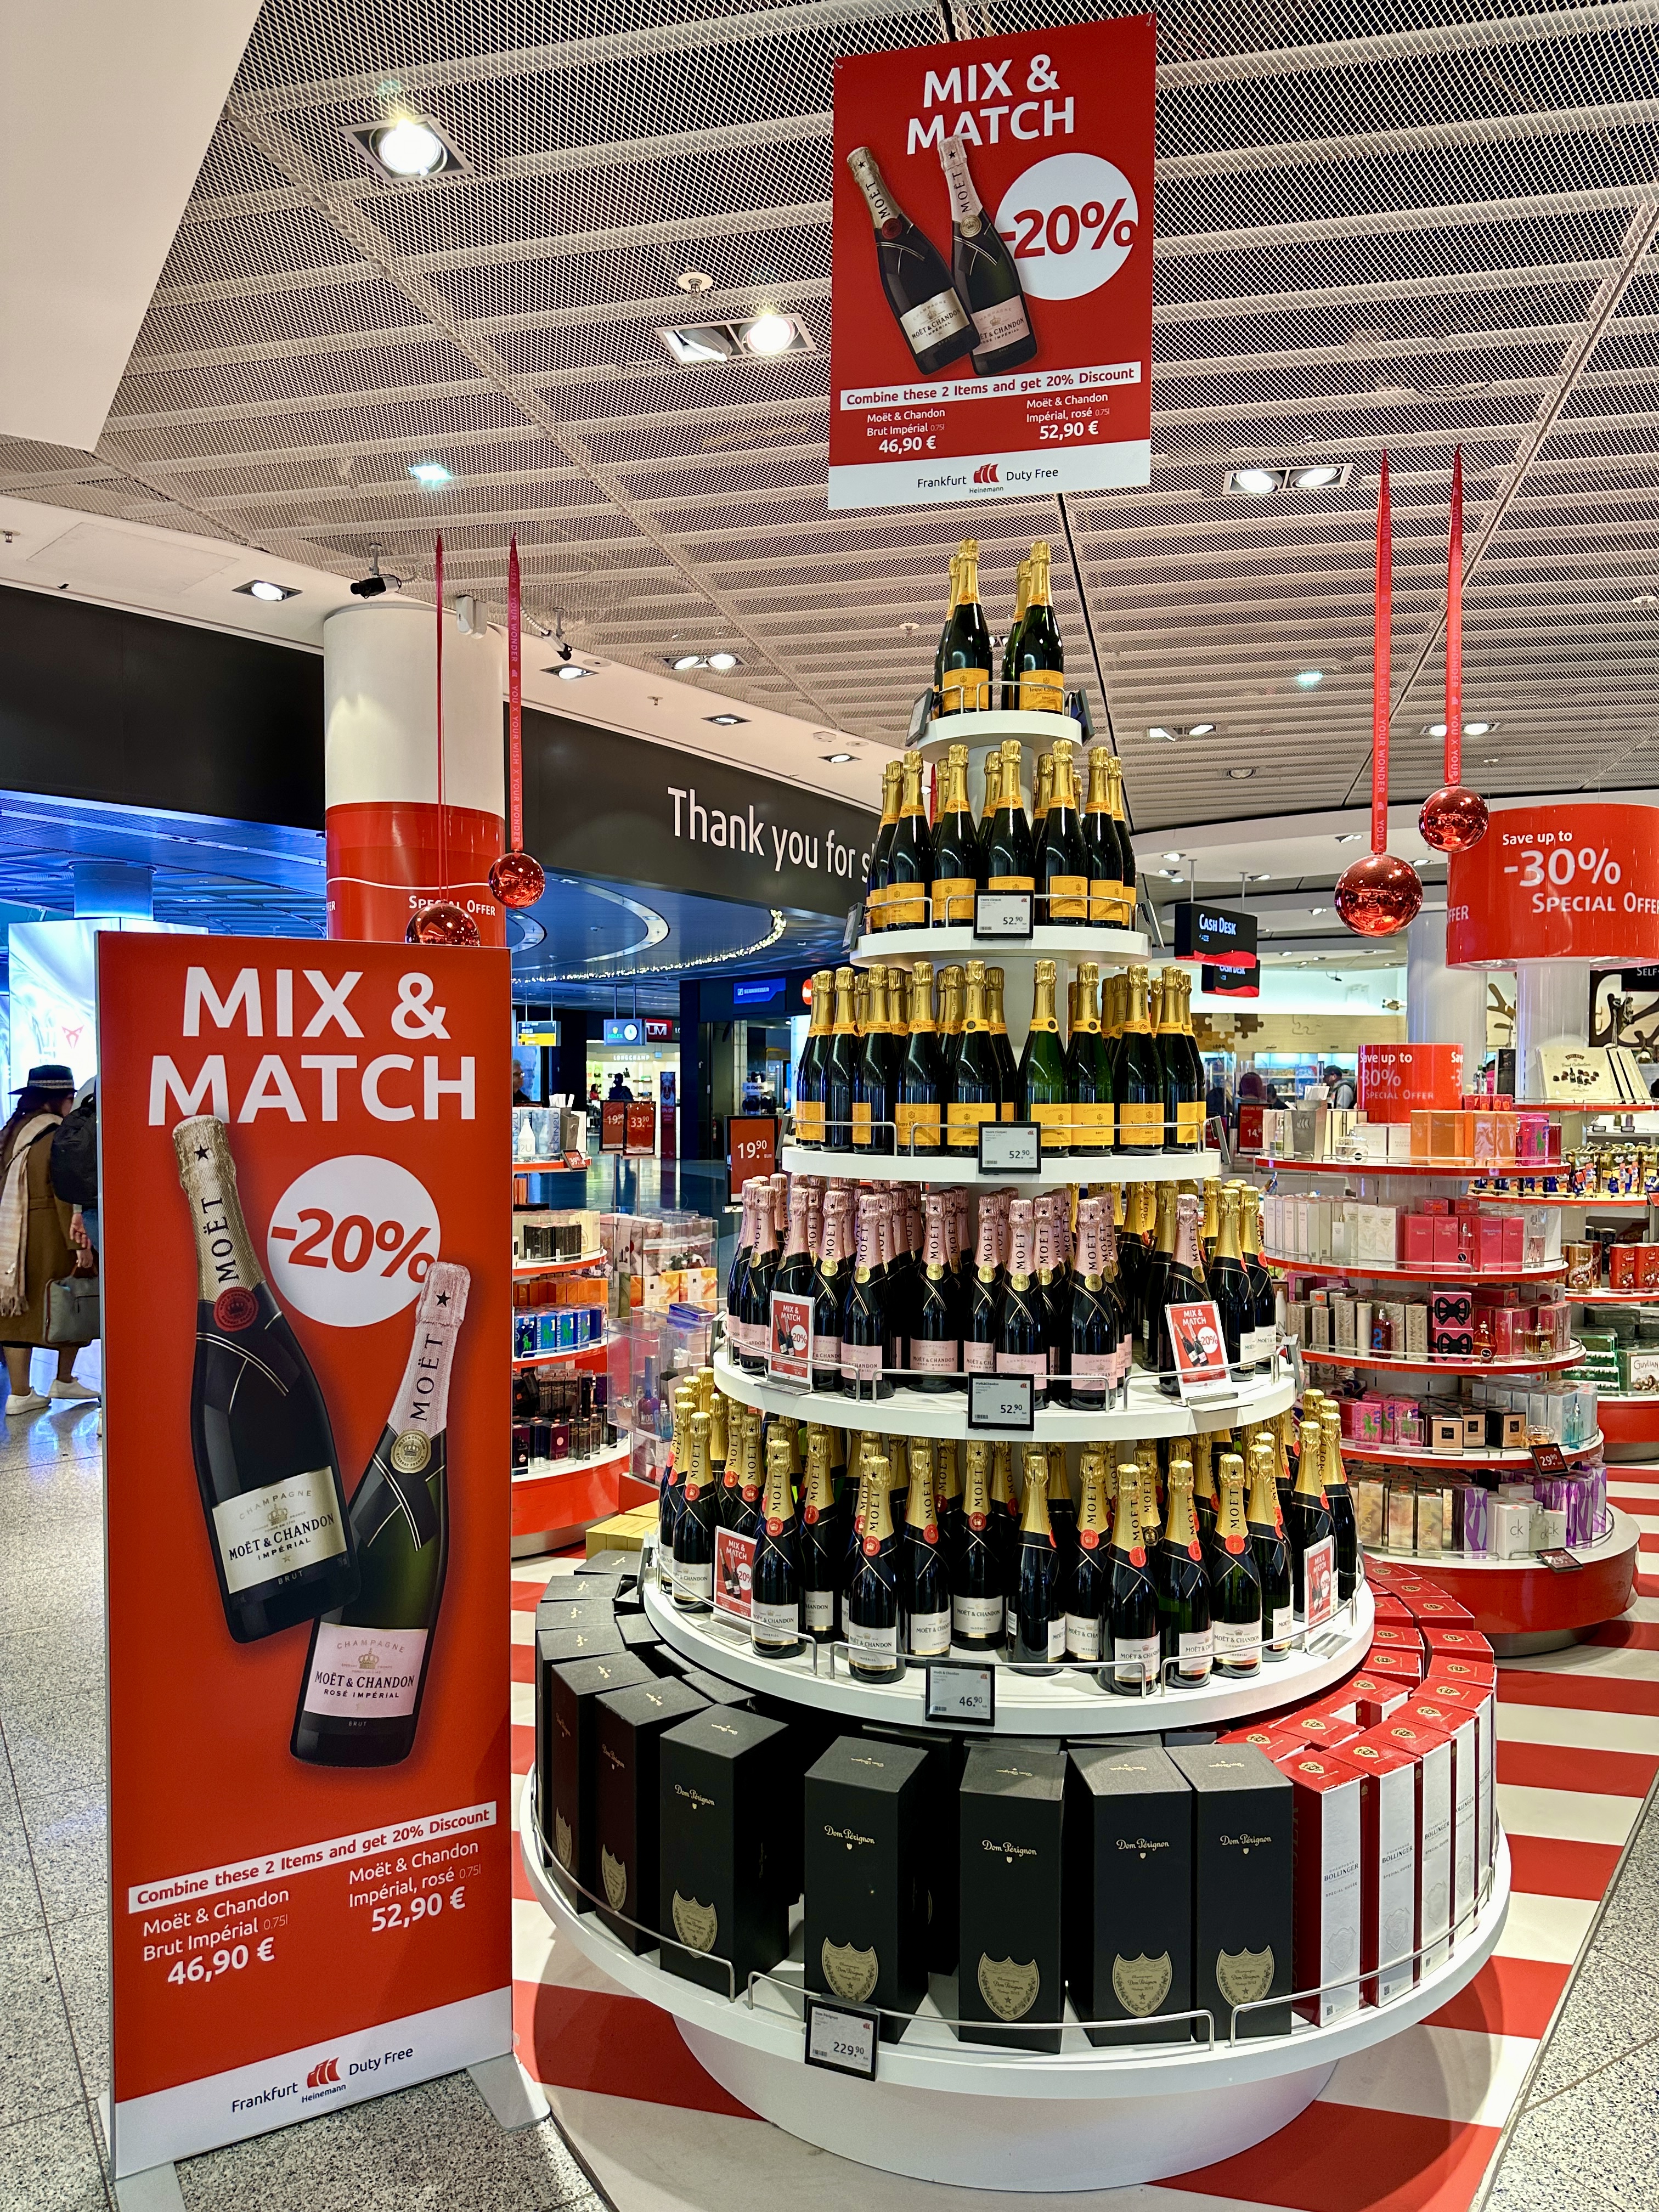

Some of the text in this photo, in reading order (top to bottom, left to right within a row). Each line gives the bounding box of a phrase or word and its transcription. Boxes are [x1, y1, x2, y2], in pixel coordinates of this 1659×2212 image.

[923, 54, 1060, 108] MIX &
[907, 96, 1074, 155] MATCH
[865, 181, 890, 220] MOËT
[952, 171, 970, 213] MOËT
[1001, 198, 1138, 259] -20%
[932, 308, 961, 328] CHANDON
[994, 318, 1024, 335] CHANDON
[847, 368, 1134, 405] Combine these 2 Items and get 20% Discount
[1027, 393, 1108, 409] Moët & Chandon
[867, 408, 945, 423] Moët & Chandon
[1027, 409, 1068, 424] Impérial,
[1071, 408, 1092, 419] rosé
[867, 426, 887, 437] Brut
[890, 423, 928, 437] Impérial
[1039, 421, 1098, 441] 52,90 €
[879, 436, 936, 455] 46,90 €
[917, 468, 1058, 488] Frankfurt Duty Free
[668, 787, 855, 878] Thank you for
[1502, 831, 1572, 846] Save up to
[1504, 848, 1621, 887] -30%
[467, 900, 495, 917] OFFER
[1532, 893, 1616, 913] SPECIAL
[1199, 914, 1236, 935] CASH DESK
[183, 966, 452, 1040] MIX &
[1381, 1054, 1396, 1065] up
[1400, 1053, 1412, 1063] to
[148, 1054, 476, 1126] MATCH
[200, 1197, 239, 1283] MOËT
[270, 1208, 436, 1284] -20%
[781, 1312, 800, 1322] MATCH
[1182, 1317, 1206, 1325] MATCH
[1183, 1310, 1197, 1318] MIX
[410, 1334, 443, 1421] MOËT
[240, 1490, 312, 1520] CHAMPAGNE
[229, 1539, 260, 1561] MOËT
[264, 1538, 272, 1547] &
[274, 1513, 335, 1543] CHANDON
[1510, 1519, 1523, 1536] ck
[258, 1538, 311, 1560] IMPÉRIAL
[726, 1547, 747, 1560] MATCH
[729, 1540, 740, 1550] MIX
[278, 1571, 303, 1584] BRUT
[337, 1640, 405, 1653] CHAMPAGNE
[315, 1671, 415, 1688] MOËT & CHANDON
[675, 1784, 715, 1806] Dom Pérignon
[825, 1825, 875, 1844] Dom Pérignon
[1116, 1838, 1170, 1851] Dom Pérignon
[1220, 1834, 1272, 1846] Dom Pérignon
[137, 1809, 489, 1904] Combine these 2 Items and get 20% Discount
[983, 1840, 1037, 1857] Dom Pérignon
[1382, 1846, 1413, 1863] BOLLINGER
[349, 1841, 478, 1884] Moët & Chandon
[1324, 1864, 1358, 1881] BOLLINGER
[349, 1878, 418, 1909] Impérial,
[422, 1866, 455, 1888] rosé
[143, 1889, 289, 1937] Moët & Chandon
[371, 1886, 466, 1932] 52,90 €
[143, 1940, 183, 1961] Brut
[188, 1918, 258, 1954] Impérial
[167, 1937, 275, 1985] 46,90 €
[232, 2047, 413, 2113] Frankfurt Duty Free
[302, 2084, 346, 2103] Heinemann
